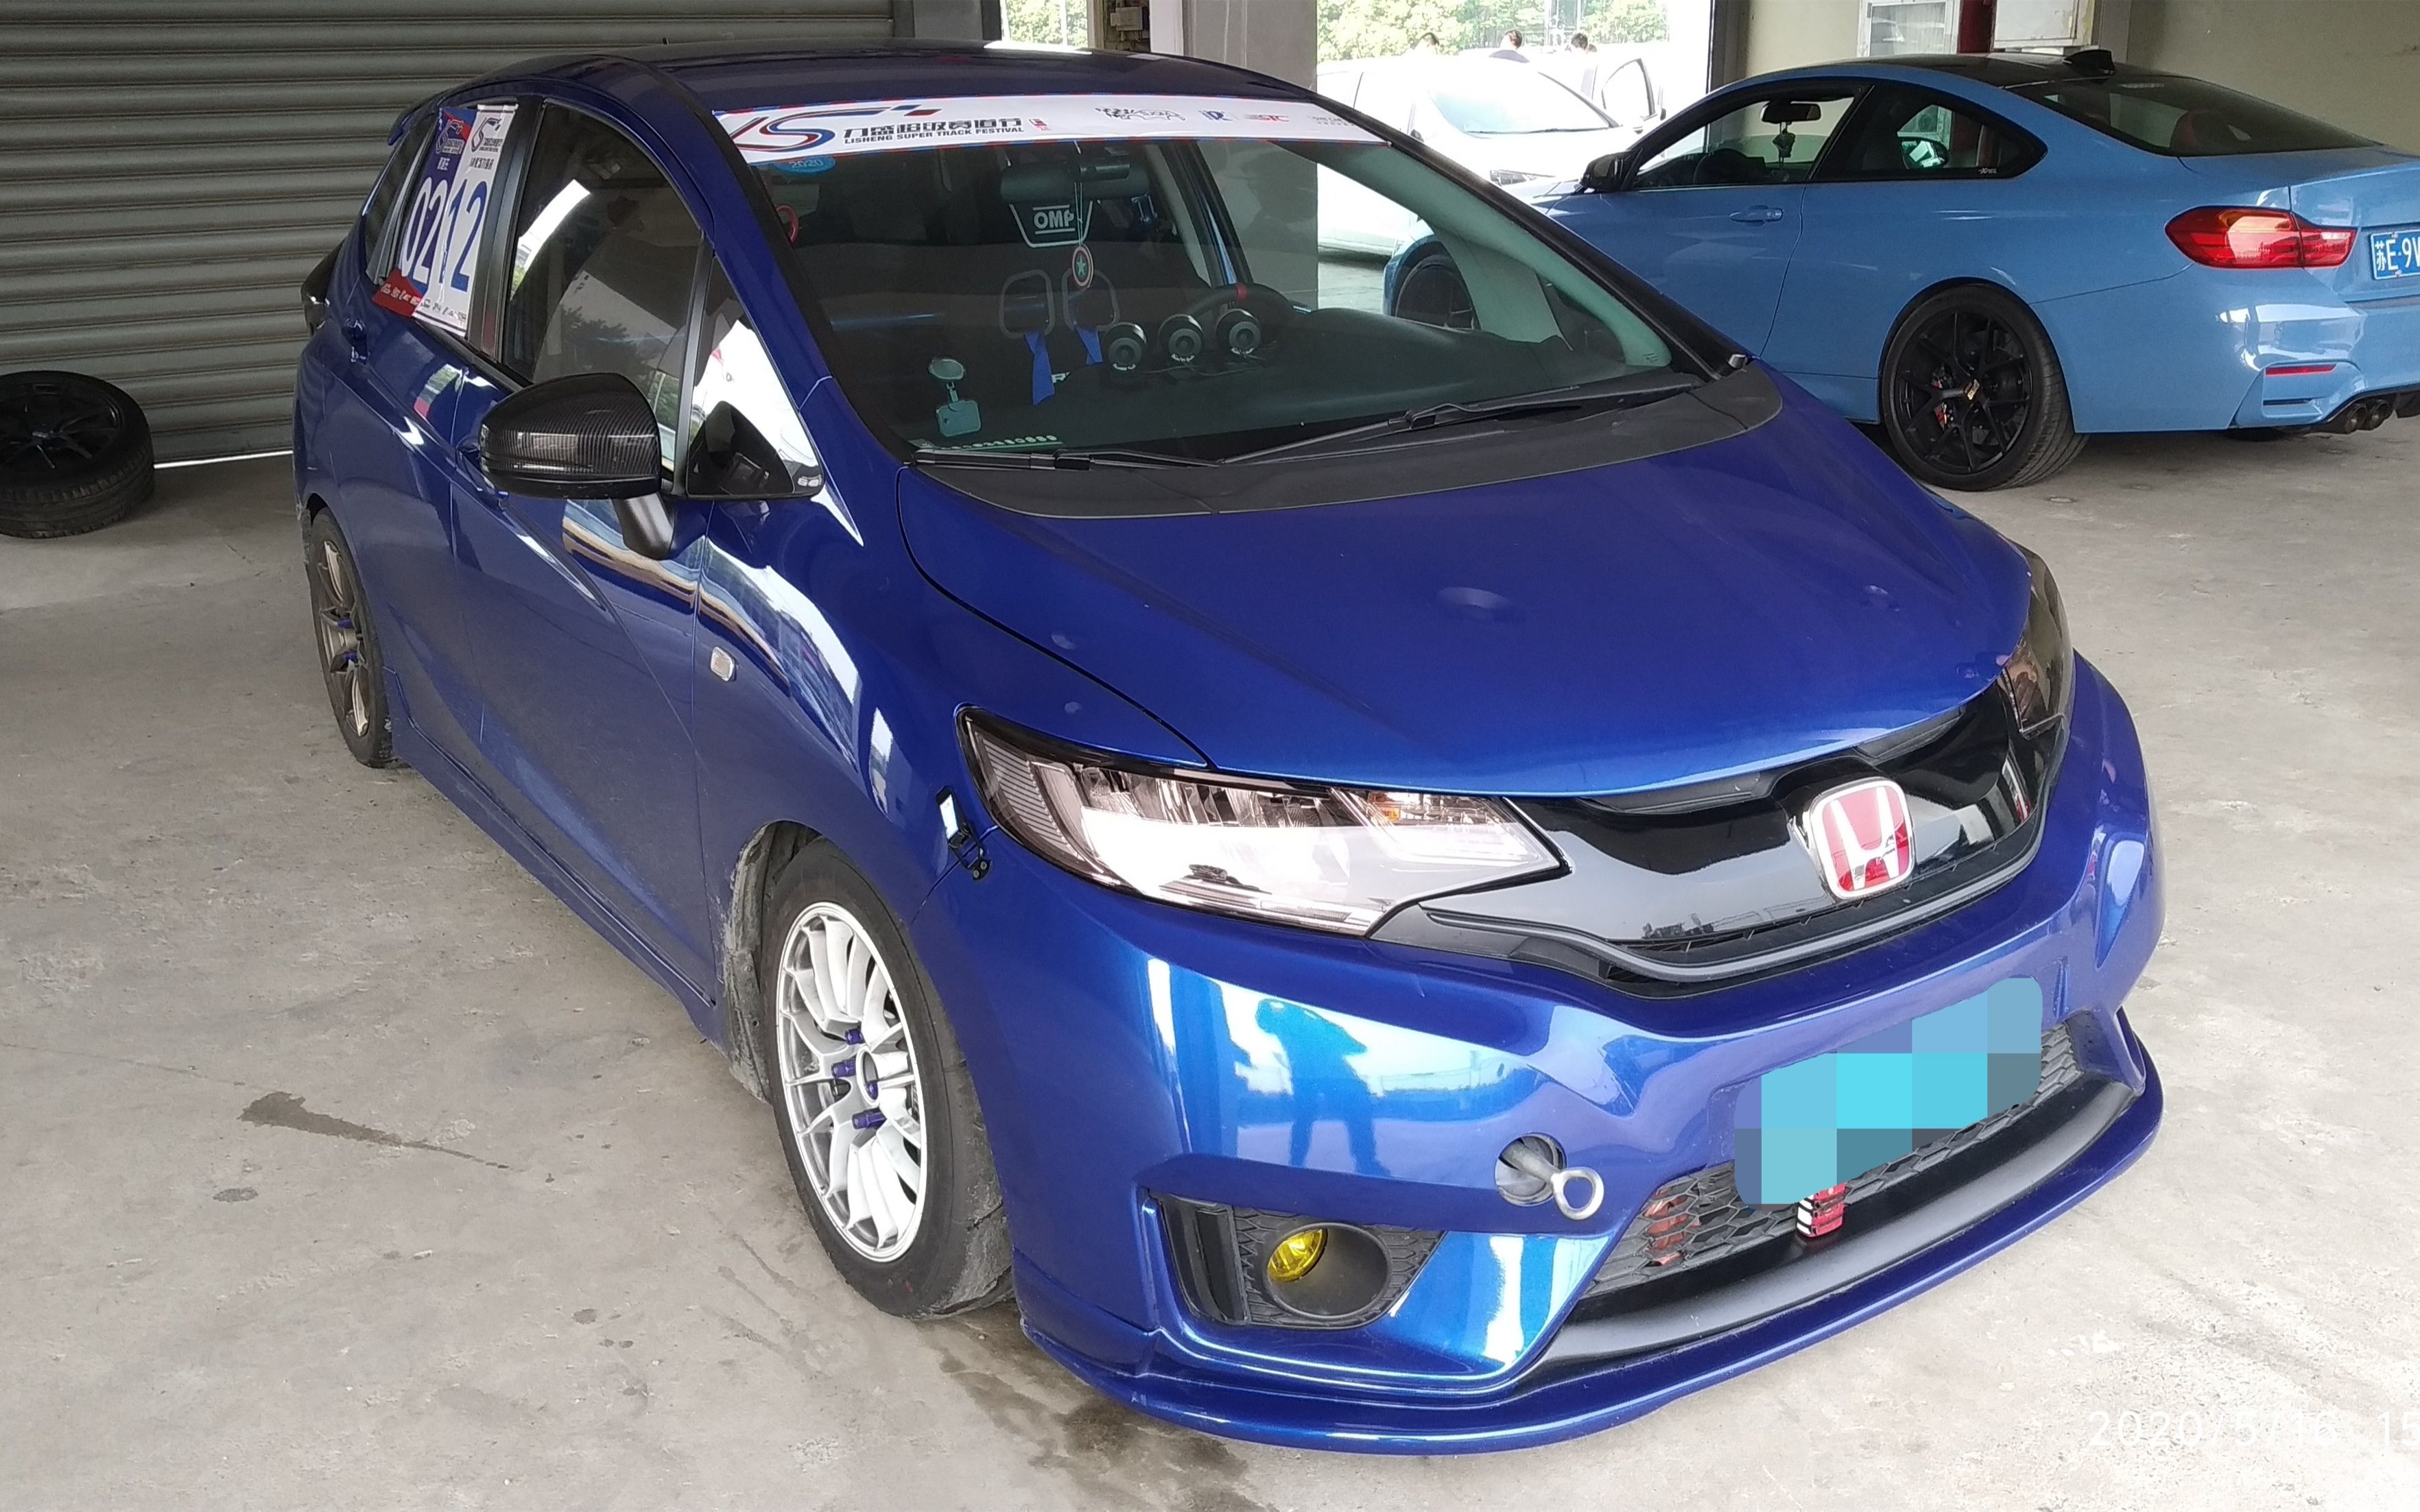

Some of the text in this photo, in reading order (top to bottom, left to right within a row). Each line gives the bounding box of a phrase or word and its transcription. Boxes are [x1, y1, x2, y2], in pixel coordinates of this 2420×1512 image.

[844, 134, 893, 144] LISHENG
[897, 132, 933, 140] SUPER
[936, 129, 972, 137] TRACK
[791, 160, 824, 169] 2020
[1034, 209, 1075, 230] OMP
[401, 176, 488, 293] 0212
